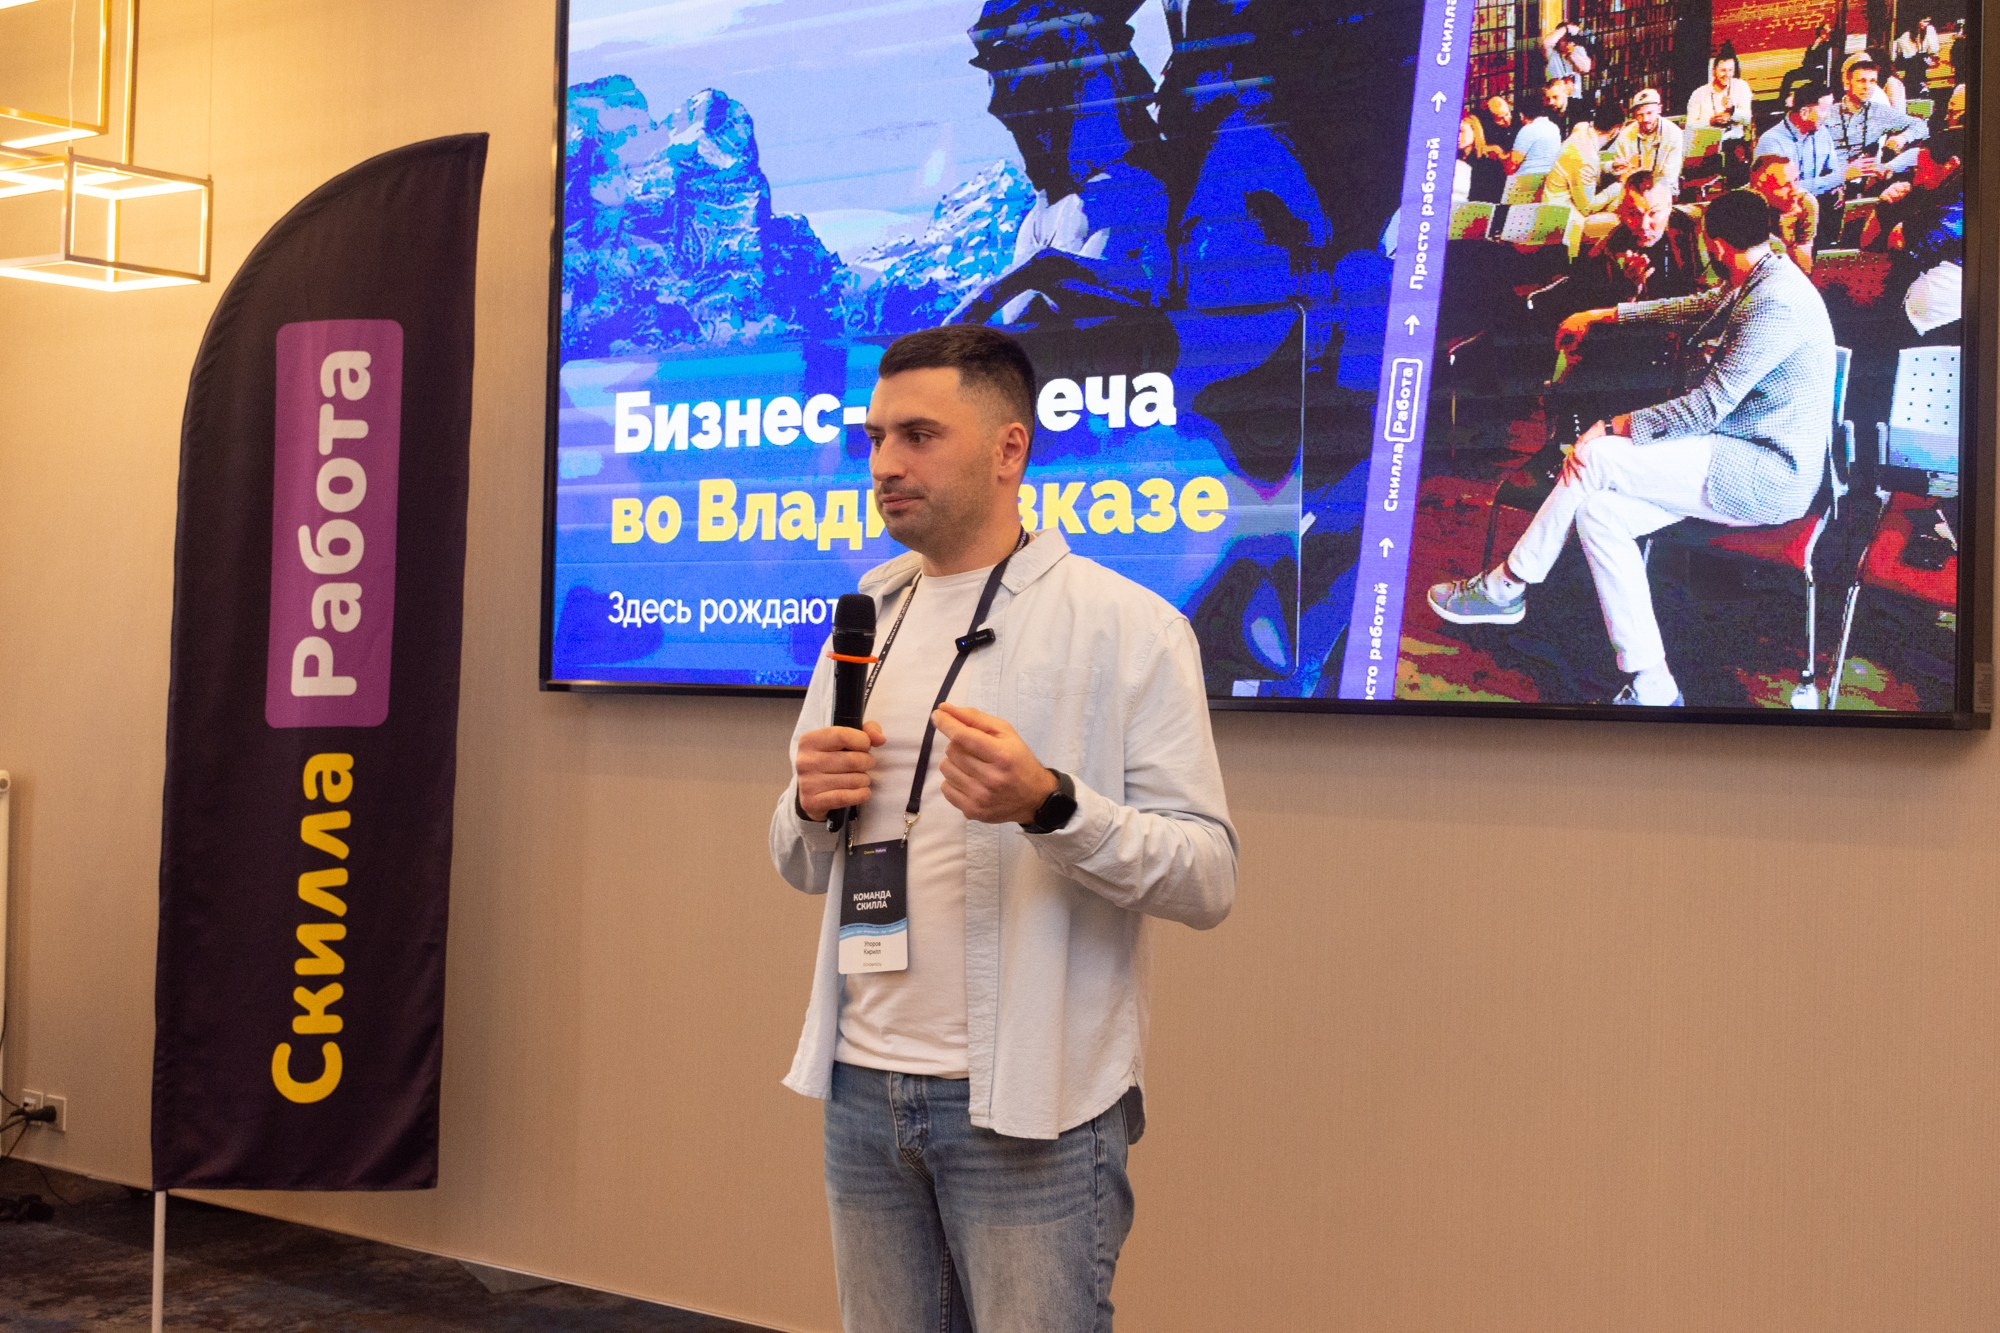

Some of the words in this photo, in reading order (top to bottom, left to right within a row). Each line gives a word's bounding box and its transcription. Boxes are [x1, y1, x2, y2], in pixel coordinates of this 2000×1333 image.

[1409, 221, 1431, 290] Просто
[1421, 137, 1441, 216] работай
[1392, 367, 1413, 434] Работа
[1384, 442, 1404, 512] Скилла
[290, 349, 373, 698] Работа
[611, 495, 682, 544] во
[607, 590, 692, 629] Здесь
[1369, 582, 1389, 661] работай
[271, 753, 354, 1104] Скилла
[853, 889, 892, 902] КОМАНДА
[856, 900, 888, 911] СКИЛЛА
